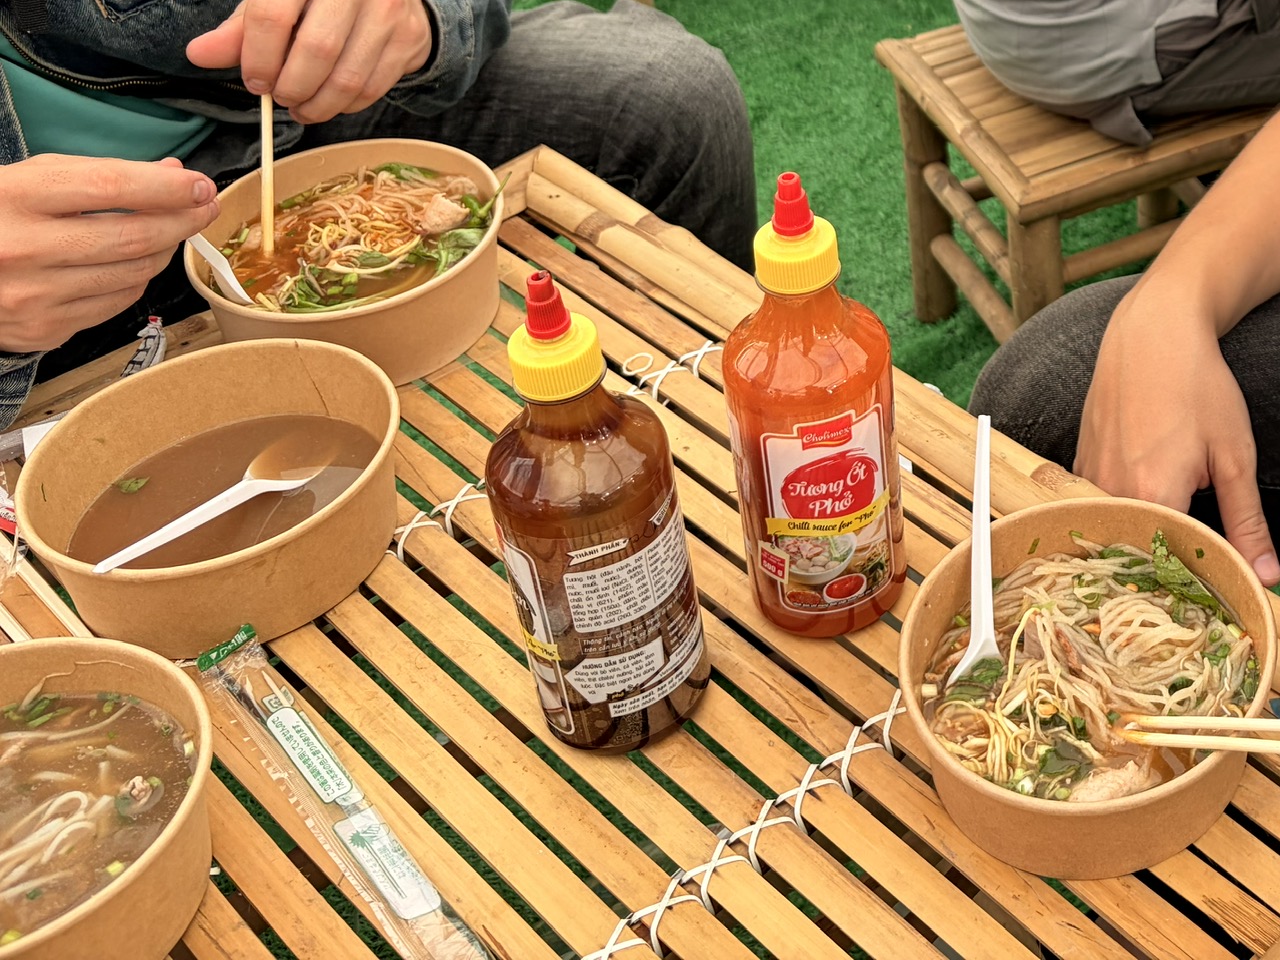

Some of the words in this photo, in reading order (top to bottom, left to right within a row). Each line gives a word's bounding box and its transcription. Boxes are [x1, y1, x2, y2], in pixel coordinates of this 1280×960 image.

[802, 427, 851, 443] Cholimex
[847, 460, 868, 486] Ớt
[809, 490, 855, 518] Phở
[787, 521, 810, 531] Chilli
[812, 523, 837, 532] sauce
[838, 520, 853, 533] for
[574, 549, 599, 560] THÀNH
